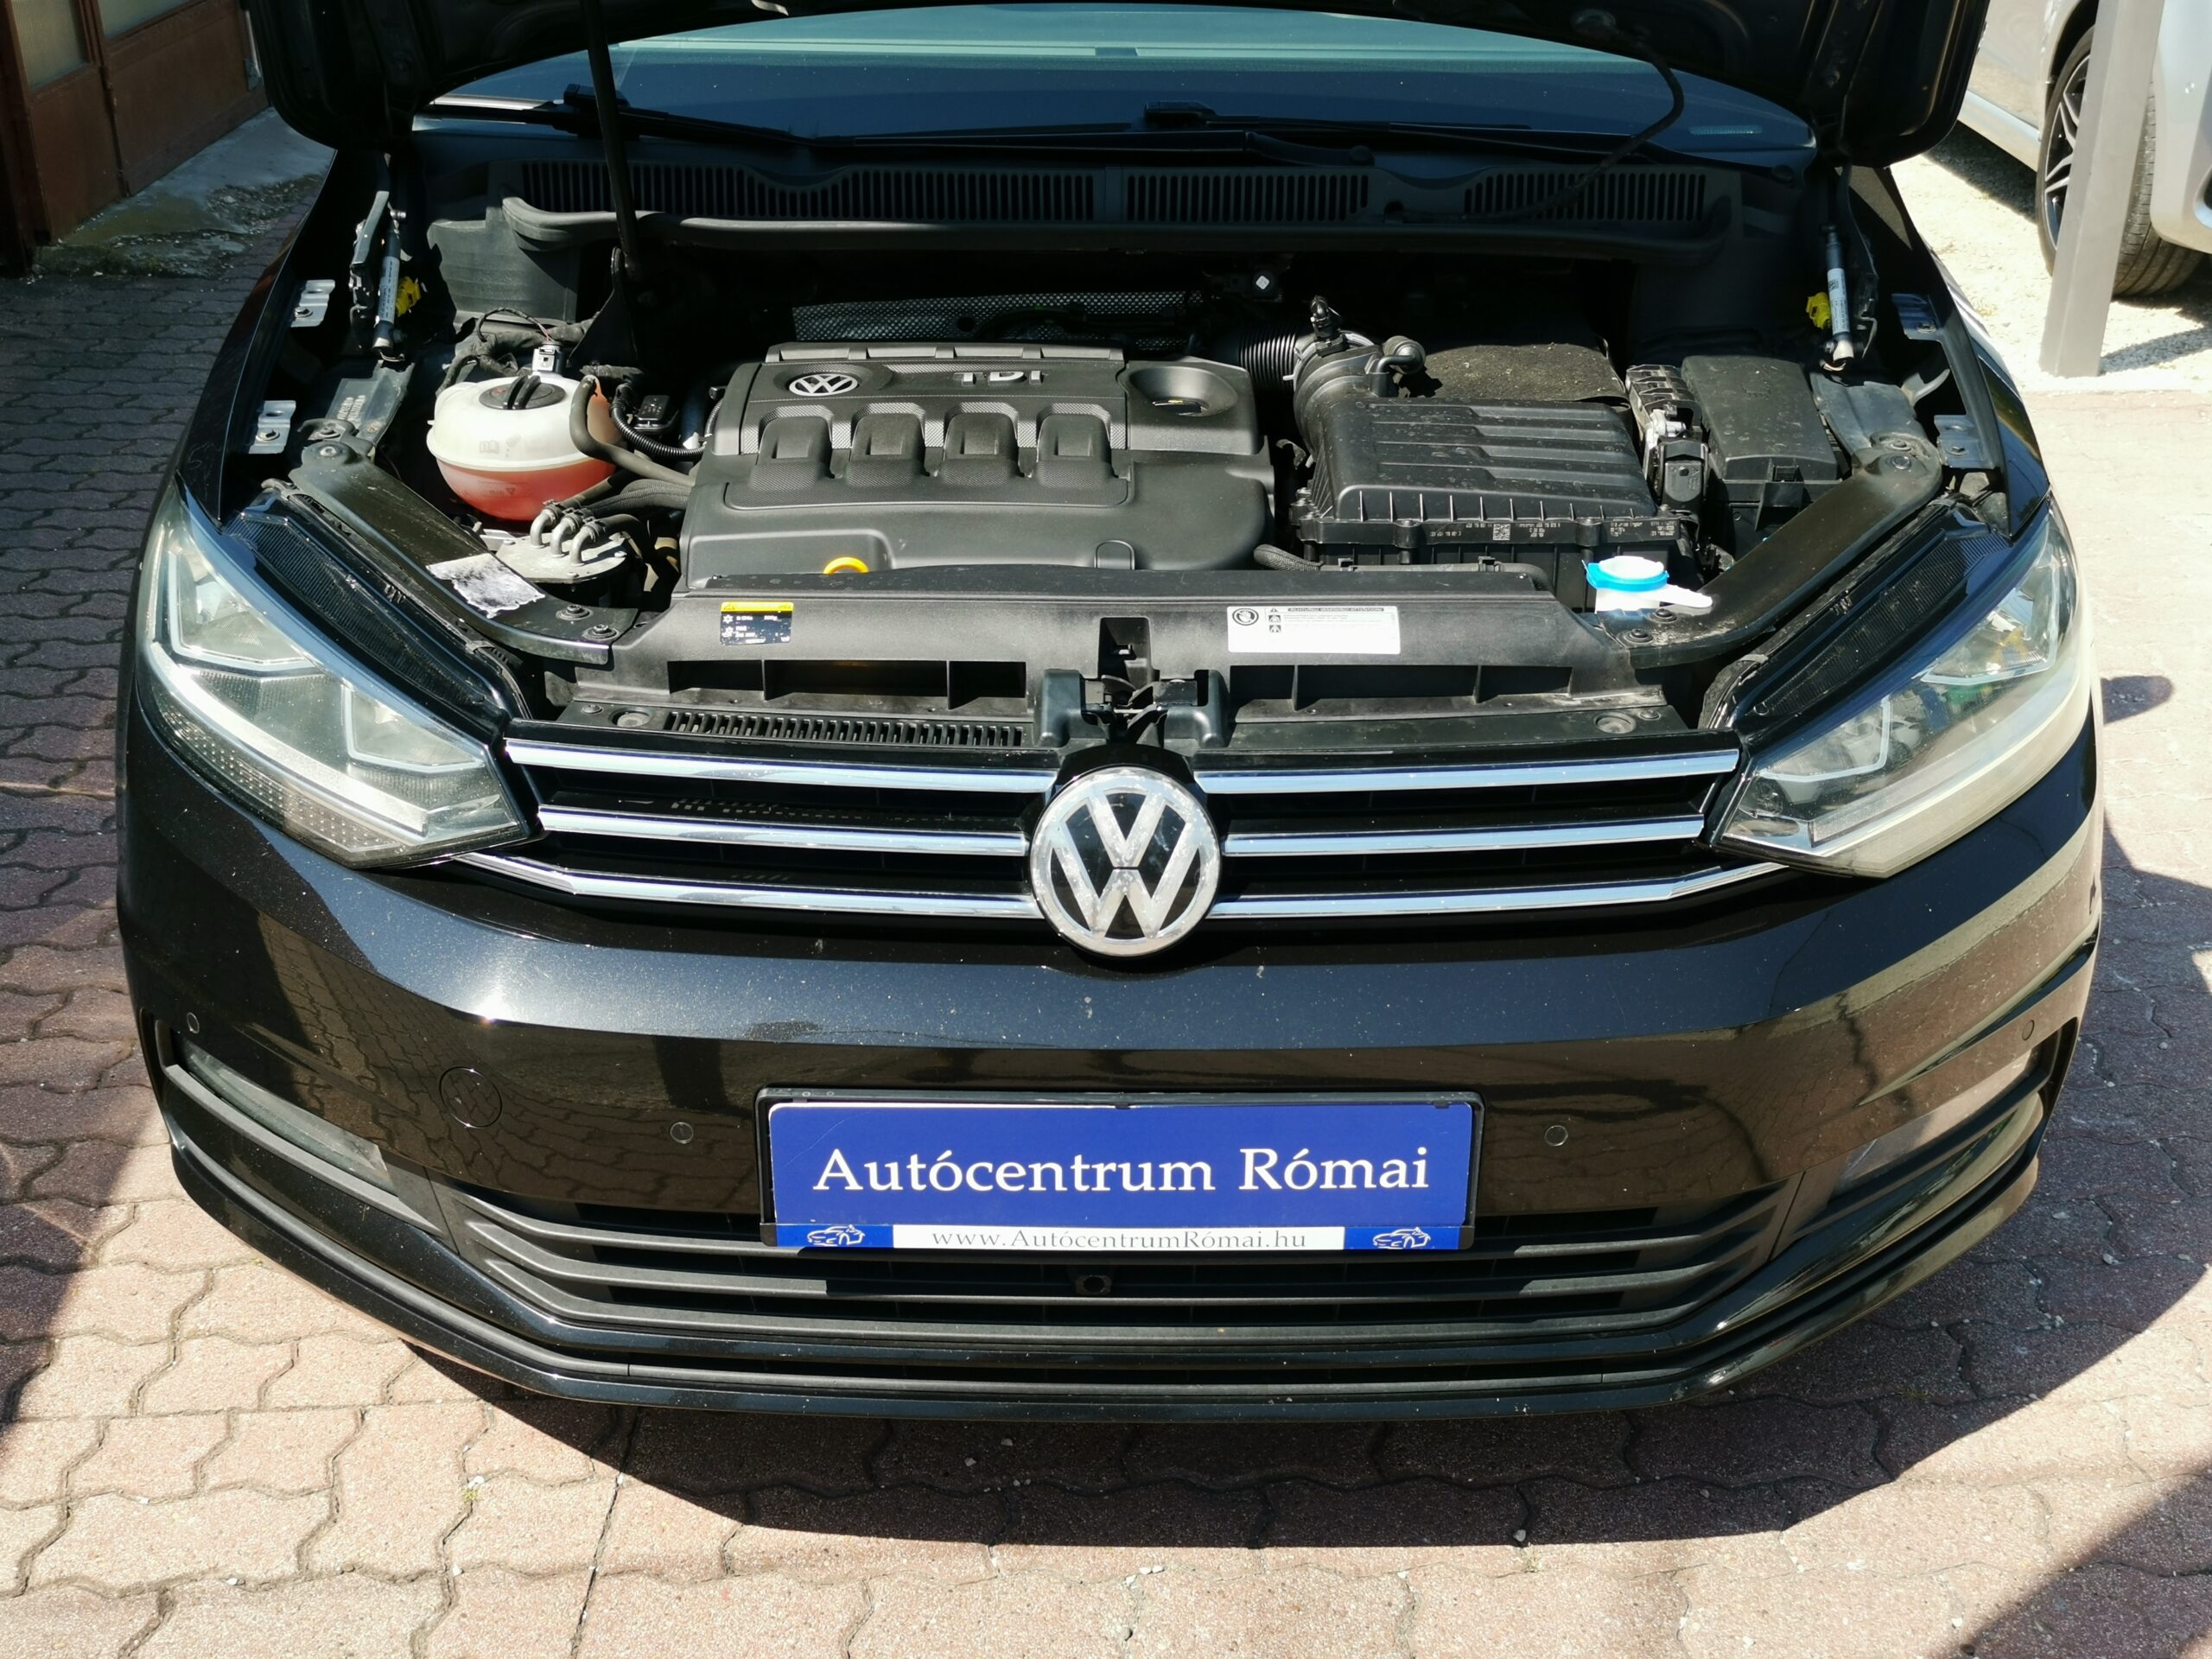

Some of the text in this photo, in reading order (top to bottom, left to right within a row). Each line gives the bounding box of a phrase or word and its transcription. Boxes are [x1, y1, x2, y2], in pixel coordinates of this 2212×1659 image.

[953, 371, 1048, 386] TDI
[1037, 774, 1213, 950] VW
[812, 1147, 1429, 1192] Autócentrum Római
[931, 1229, 1306, 1251] www.AutócentrumRómai.hu
